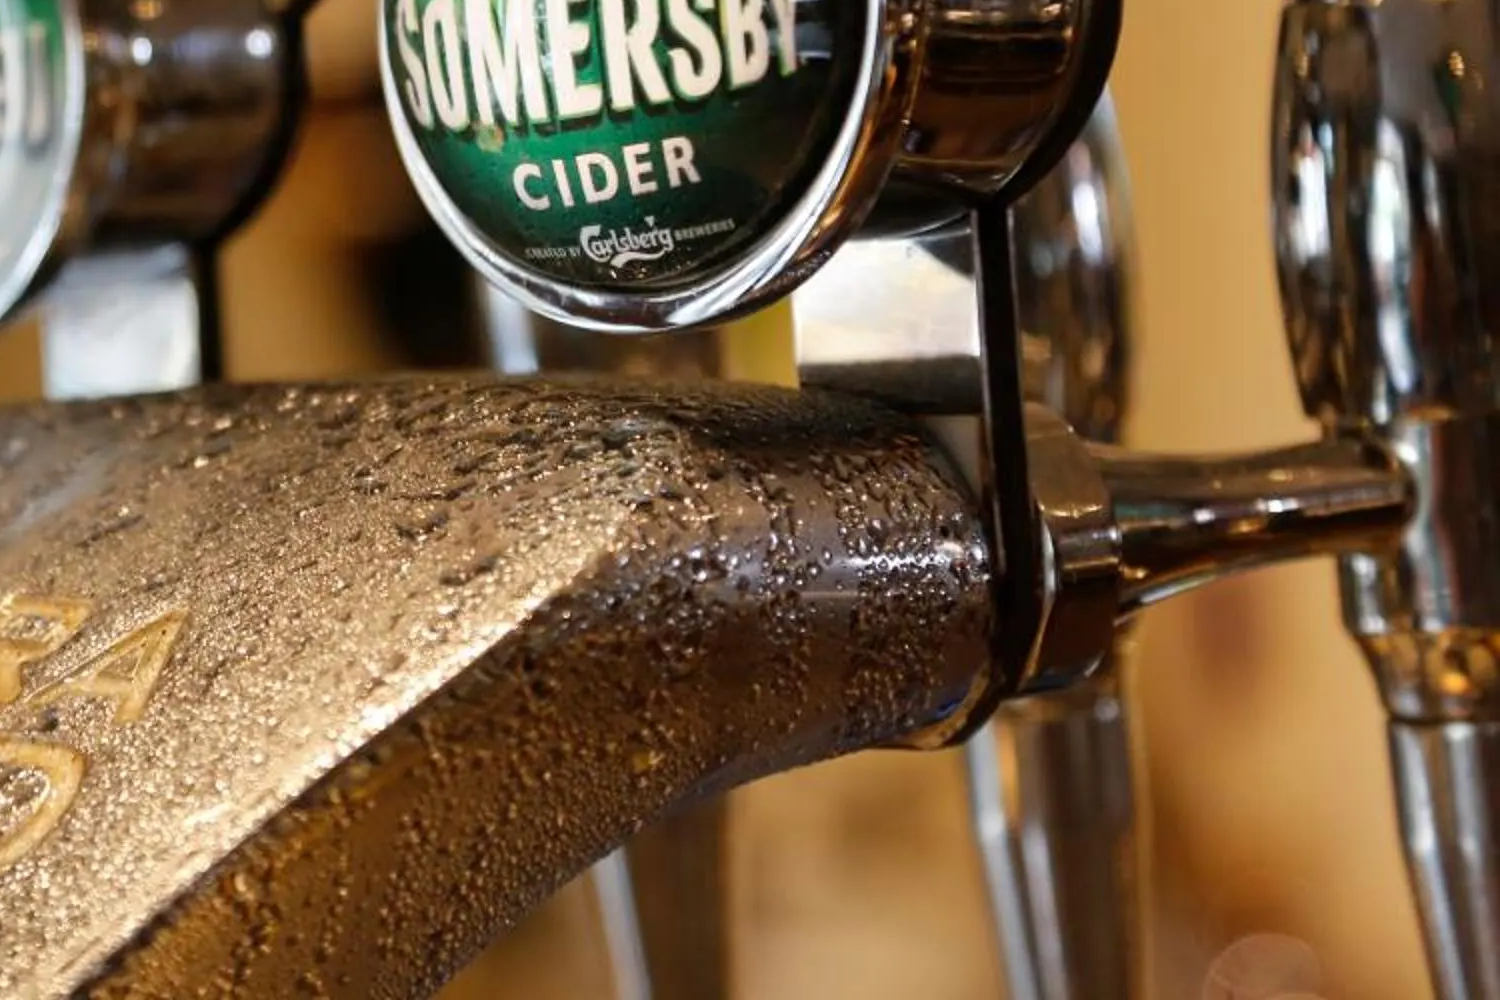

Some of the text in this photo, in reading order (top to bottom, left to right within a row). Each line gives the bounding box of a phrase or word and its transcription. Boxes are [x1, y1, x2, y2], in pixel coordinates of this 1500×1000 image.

[513, 136, 701, 211] CIDER
[580, 222, 674, 268] Carlsberg
[674, 218, 736, 241] BREWERIES
